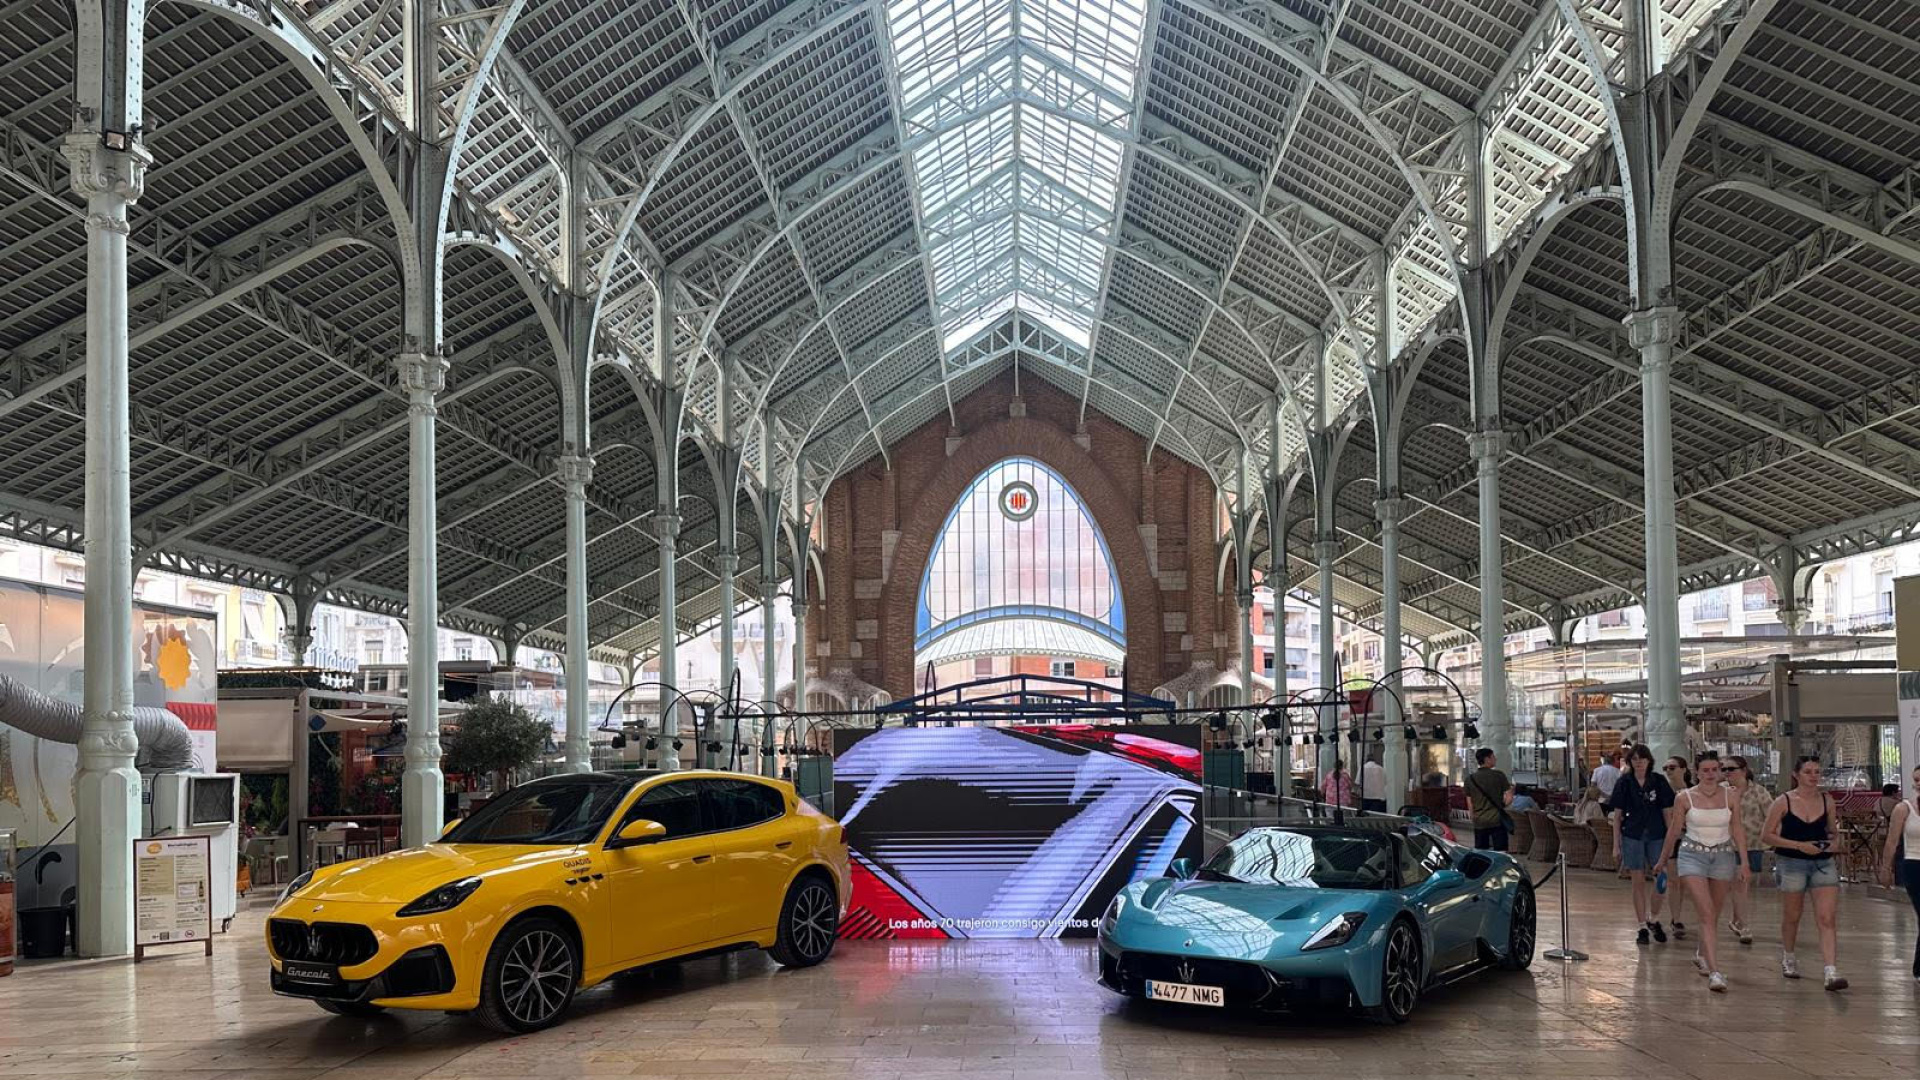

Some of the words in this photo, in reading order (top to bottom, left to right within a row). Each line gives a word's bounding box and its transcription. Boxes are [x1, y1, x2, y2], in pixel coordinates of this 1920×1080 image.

[563, 857, 592, 868] QUADIS
[889, 918, 908, 929] Los
[911, 918, 937, 929] años
[940, 918, 954, 929] 70
[957, 917, 998, 931] trajeron
[1001, 917, 1045, 930] consigo
[1048, 917, 1089, 928] vientos
[1091, 917, 1100, 928] d
[287, 966, 331, 979] Grecale
[1153, 983, 1188, 1000] 4477
[1192, 987, 1220, 1004] NMG
